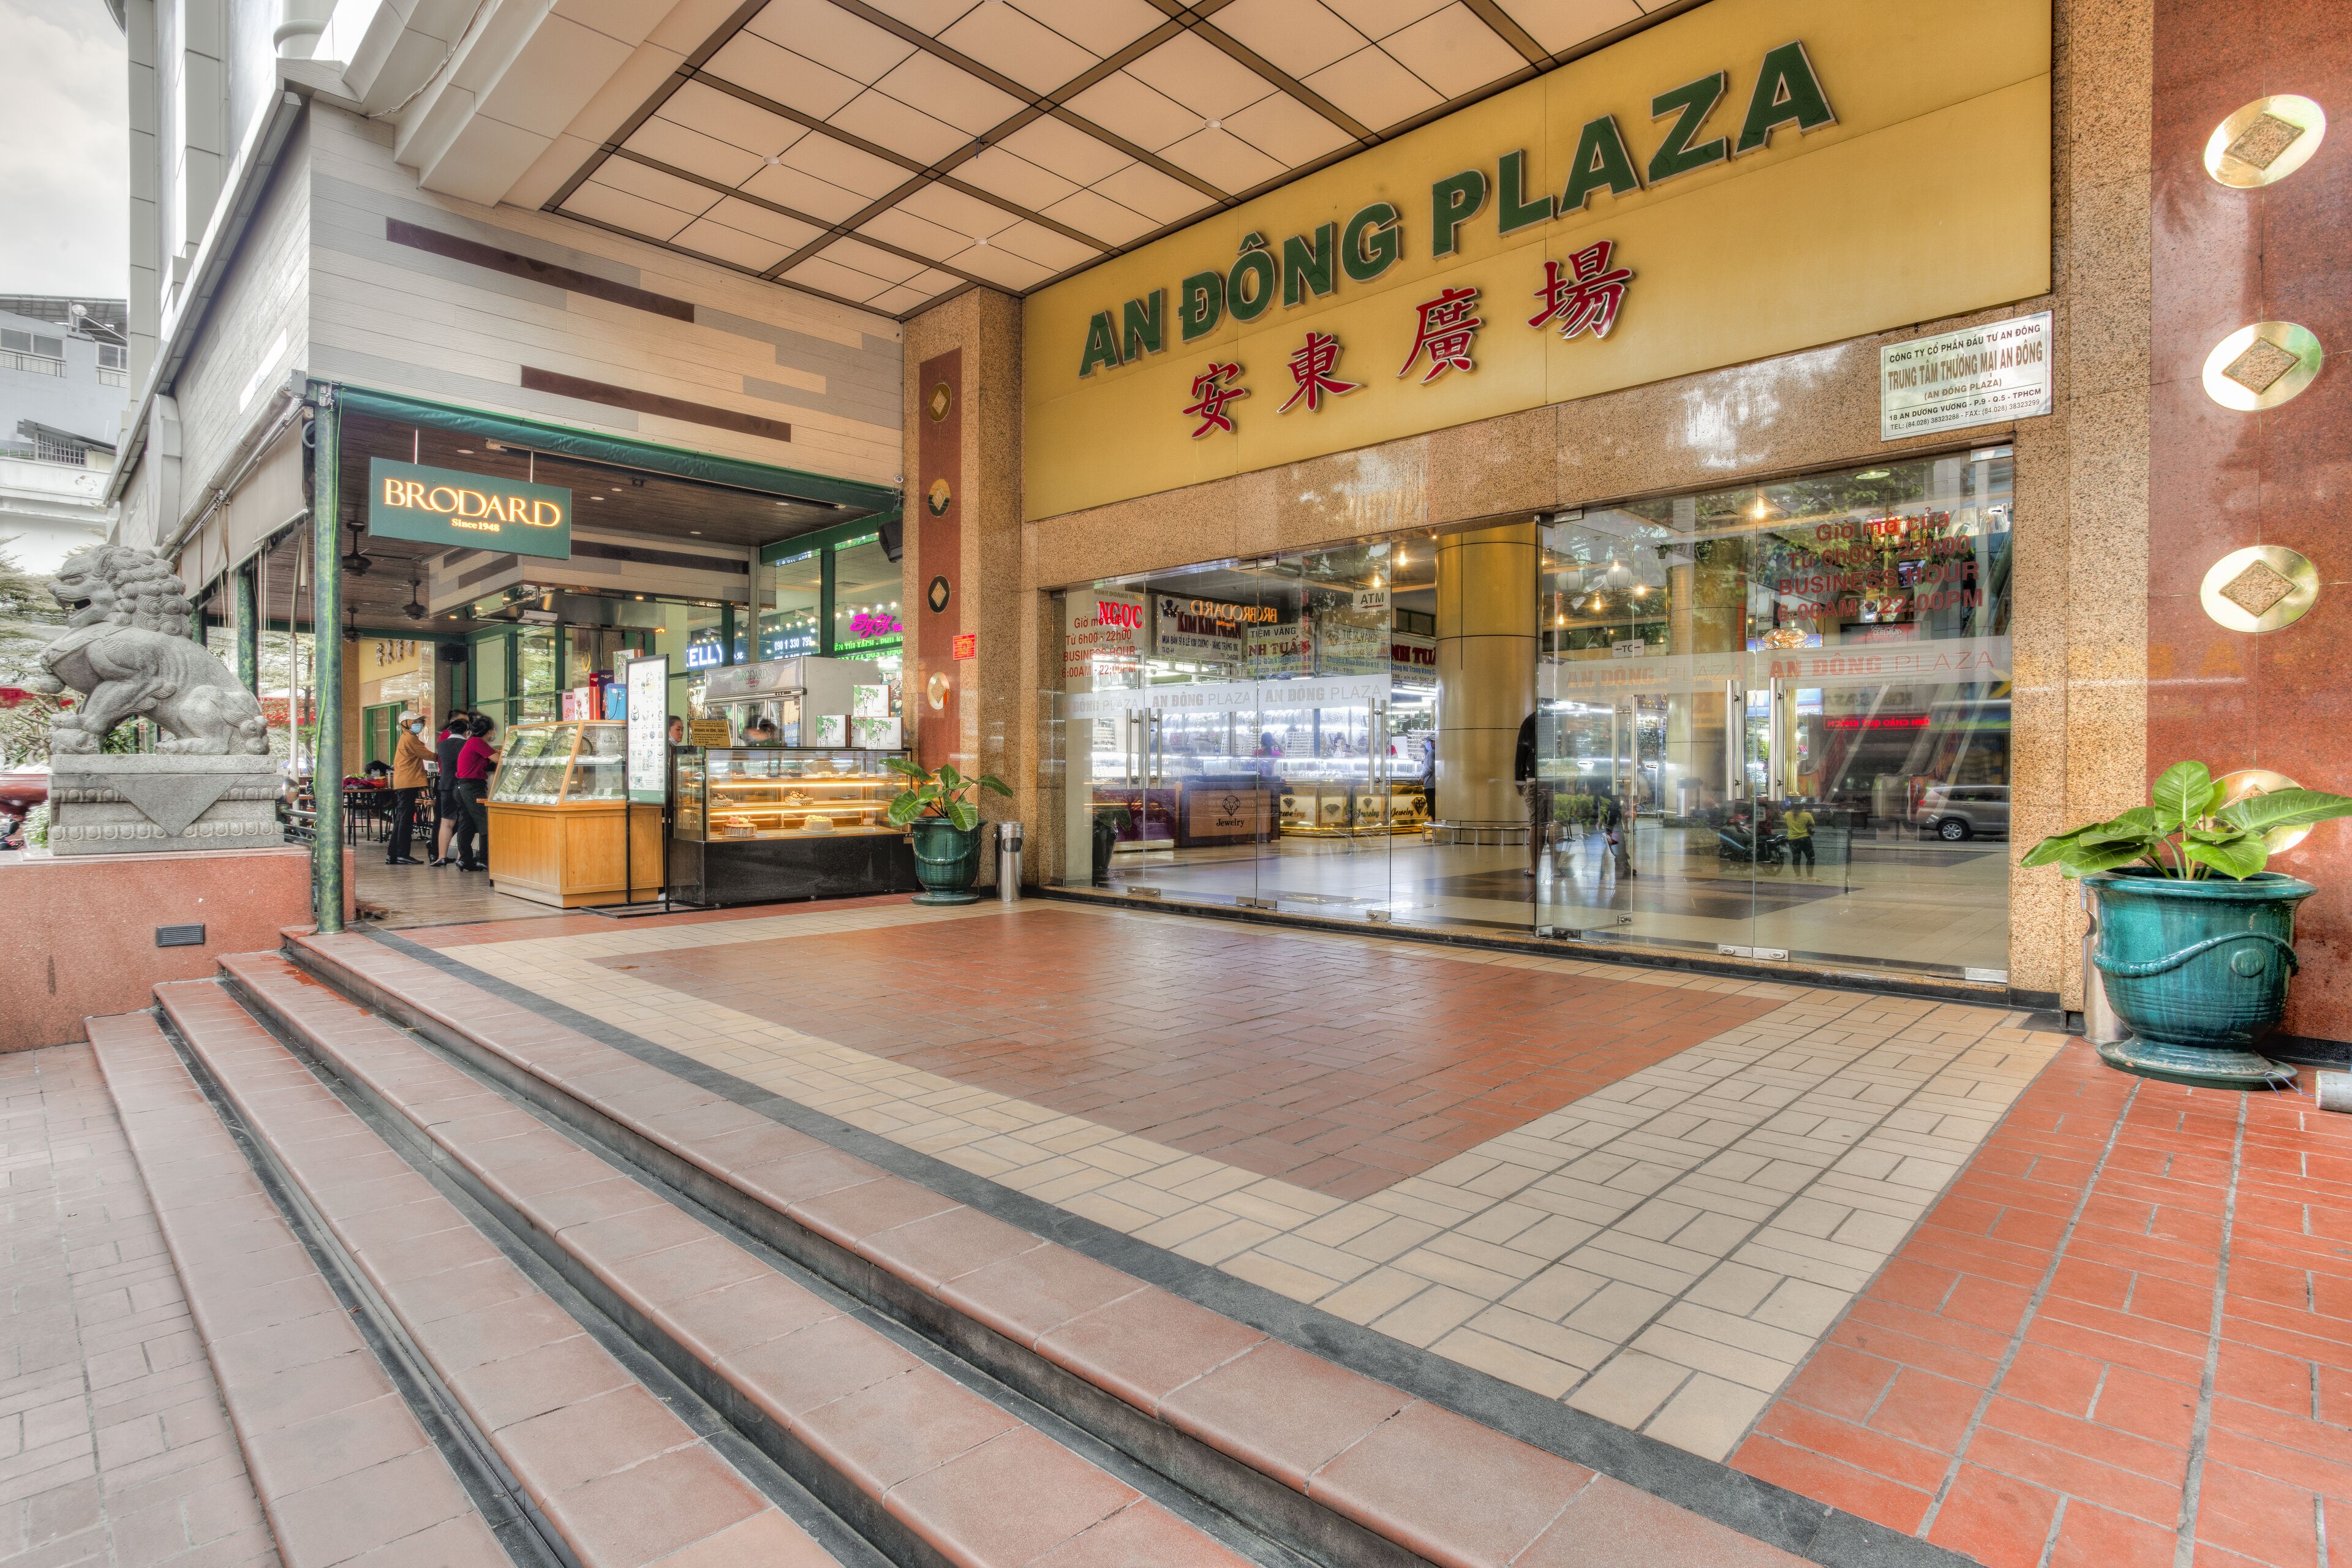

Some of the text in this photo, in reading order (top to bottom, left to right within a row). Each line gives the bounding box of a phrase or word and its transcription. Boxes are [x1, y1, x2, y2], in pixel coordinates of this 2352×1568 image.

[1078, 39, 1838, 380] AN ĐÔNG PLAZA
[1182, 239, 1635, 440] 安東廣場
[1890, 324, 2041, 363] CÔNG TY CỔ PHẦN ĐẦU TƯ AN ĐÔNG
[1888, 339, 2043, 391] TRUNG TÂM THƯƠNG MẠI AN ĐÔNG
[1924, 378, 2002, 401] (AN ĐÔNG PLAZA)
[1912, 407, 1938, 417] DƯƠNG
[1940, 401, 1967, 412] VƯƠNG
[1993, 394, 2005, 403] Q.5
[2013, 388, 2041, 399] TPHCM
[1905, 418, 1929, 429] (84.028)
[1931, 413, 1959, 423] 38323288
[1982, 405, 2007, 416] (84.028)
[2009, 399, 2040, 410] 38323299
[383, 477, 562, 528] BRODARD
[451, 518, 500, 532] Since 1948
[1816, 507, 1950, 541] Giờ mở cửa
[1787, 535, 1970, 570] Từ 6h00 22h00
[1779, 568, 1898, 596] BUSINESS
[1906, 561, 1980, 585] HOUR
[1360, 592, 1384, 605] ATM
[1777, 588, 1983, 622] 6:00AM 22:00PM
[1074, 615, 1088, 628] Giờ
[1274, 627, 1296, 636] VÀNG
[774, 641, 783, 651] 090
[790, 639, 799, 649] 330
[1079, 632, 1098, 644] 6h00
[1106, 629, 1132, 642] 22h00
[687, 644, 722, 667] ELLY
[1063, 647, 1107, 662] BUSINESS
[1110, 645, 1136, 657] HOUR
[1770, 650, 1996, 678] AN ĐÔNG PLAZA
[738, 668, 768, 682] BRODARD
[1061, 662, 1136, 678] 6:00AM 22:00PM
[1409, 665, 1421, 674] Trang
[1567, 664, 1744, 688] AN ĐÔNG PLAZA
[1152, 691, 1251, 707] AN ĐÔNG PLAZA
[1265, 684, 1382, 703] AN ĐÔNG PLAZA
[1072, 698, 1099, 712] ĐÔNG
[1103, 698, 1138, 711] PLAZA
[1391, 807, 1414, 817] Jewelry
[1216, 818, 1245, 828] Jewelry
